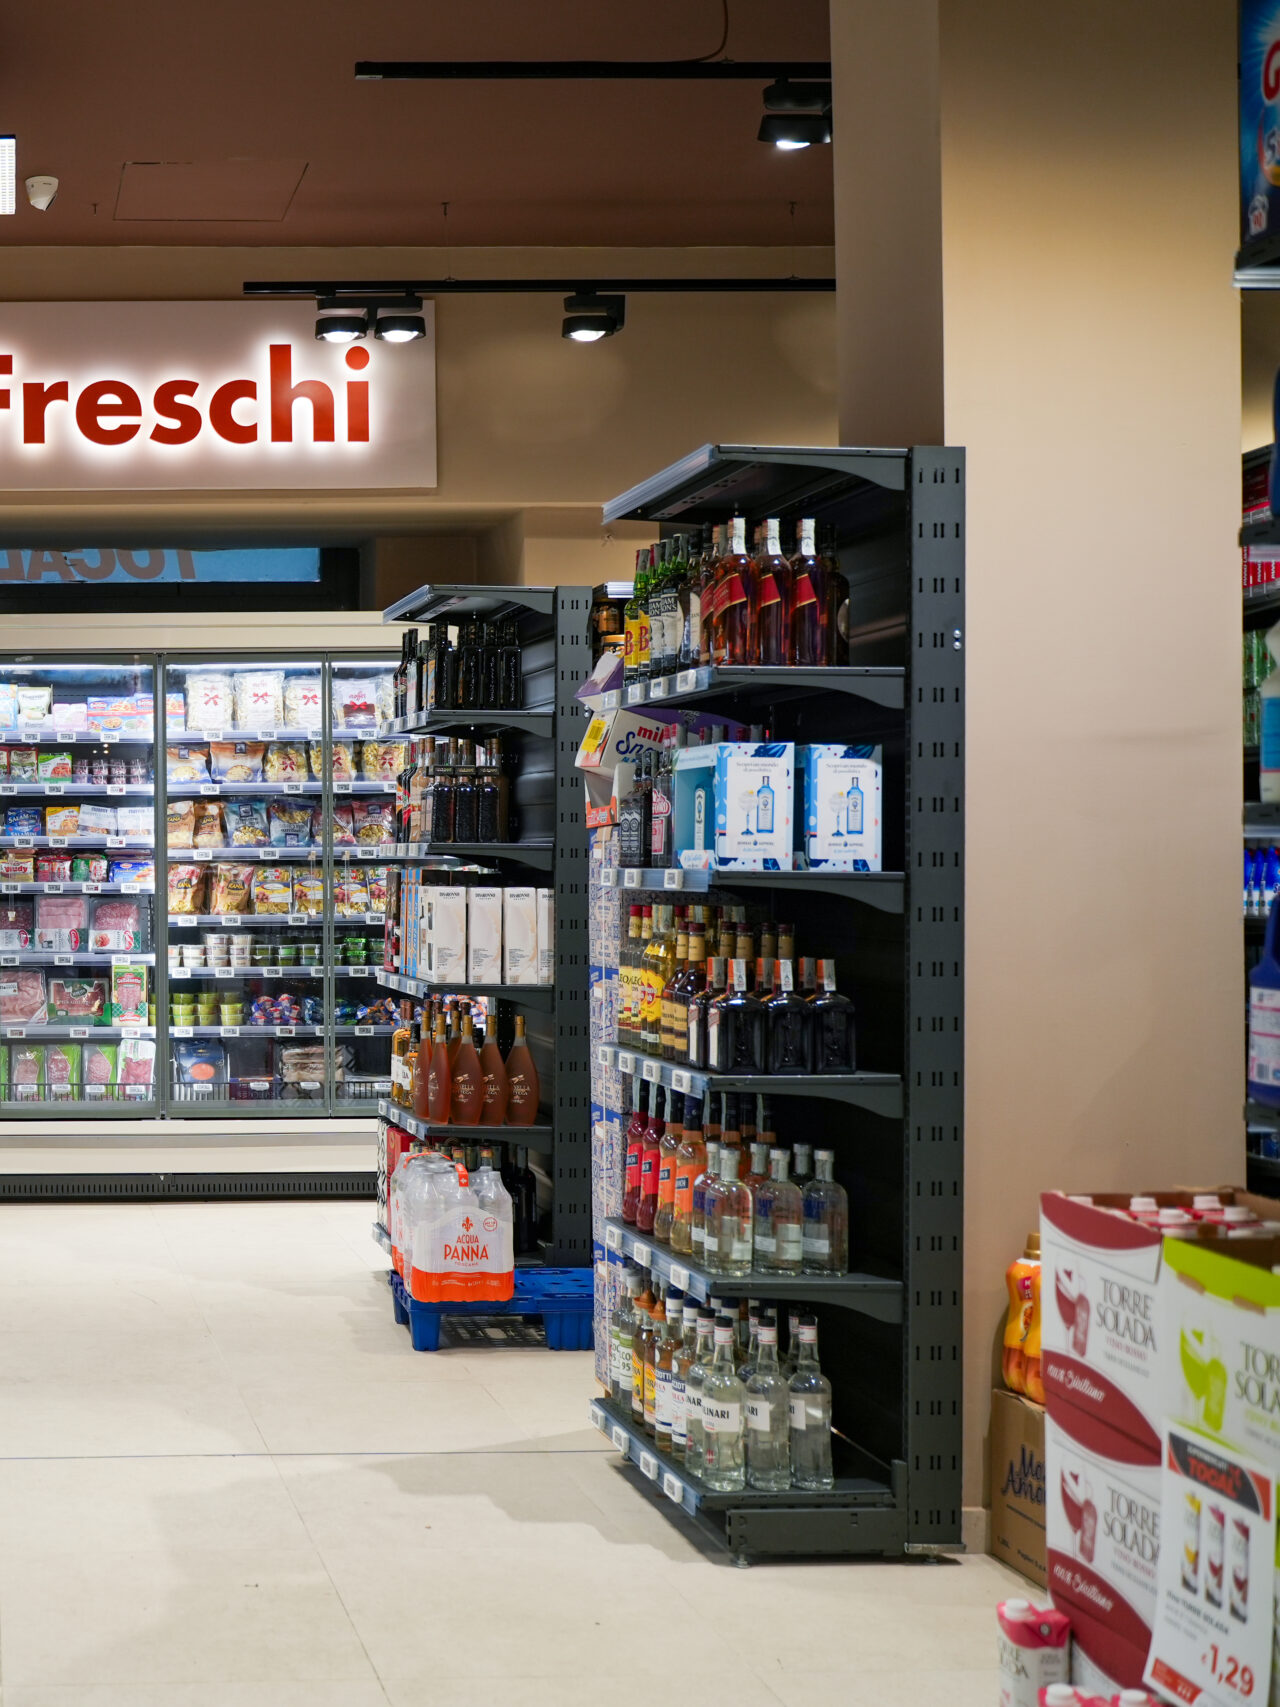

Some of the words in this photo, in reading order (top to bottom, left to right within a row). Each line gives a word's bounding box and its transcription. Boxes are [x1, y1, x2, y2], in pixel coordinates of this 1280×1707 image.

[444, 1244, 489, 1262] PANNA
[456, 1234, 480, 1244] ACQUA
[1100, 1277, 1154, 1321] TORRE
[1096, 1302, 1157, 1353] SOLADA
